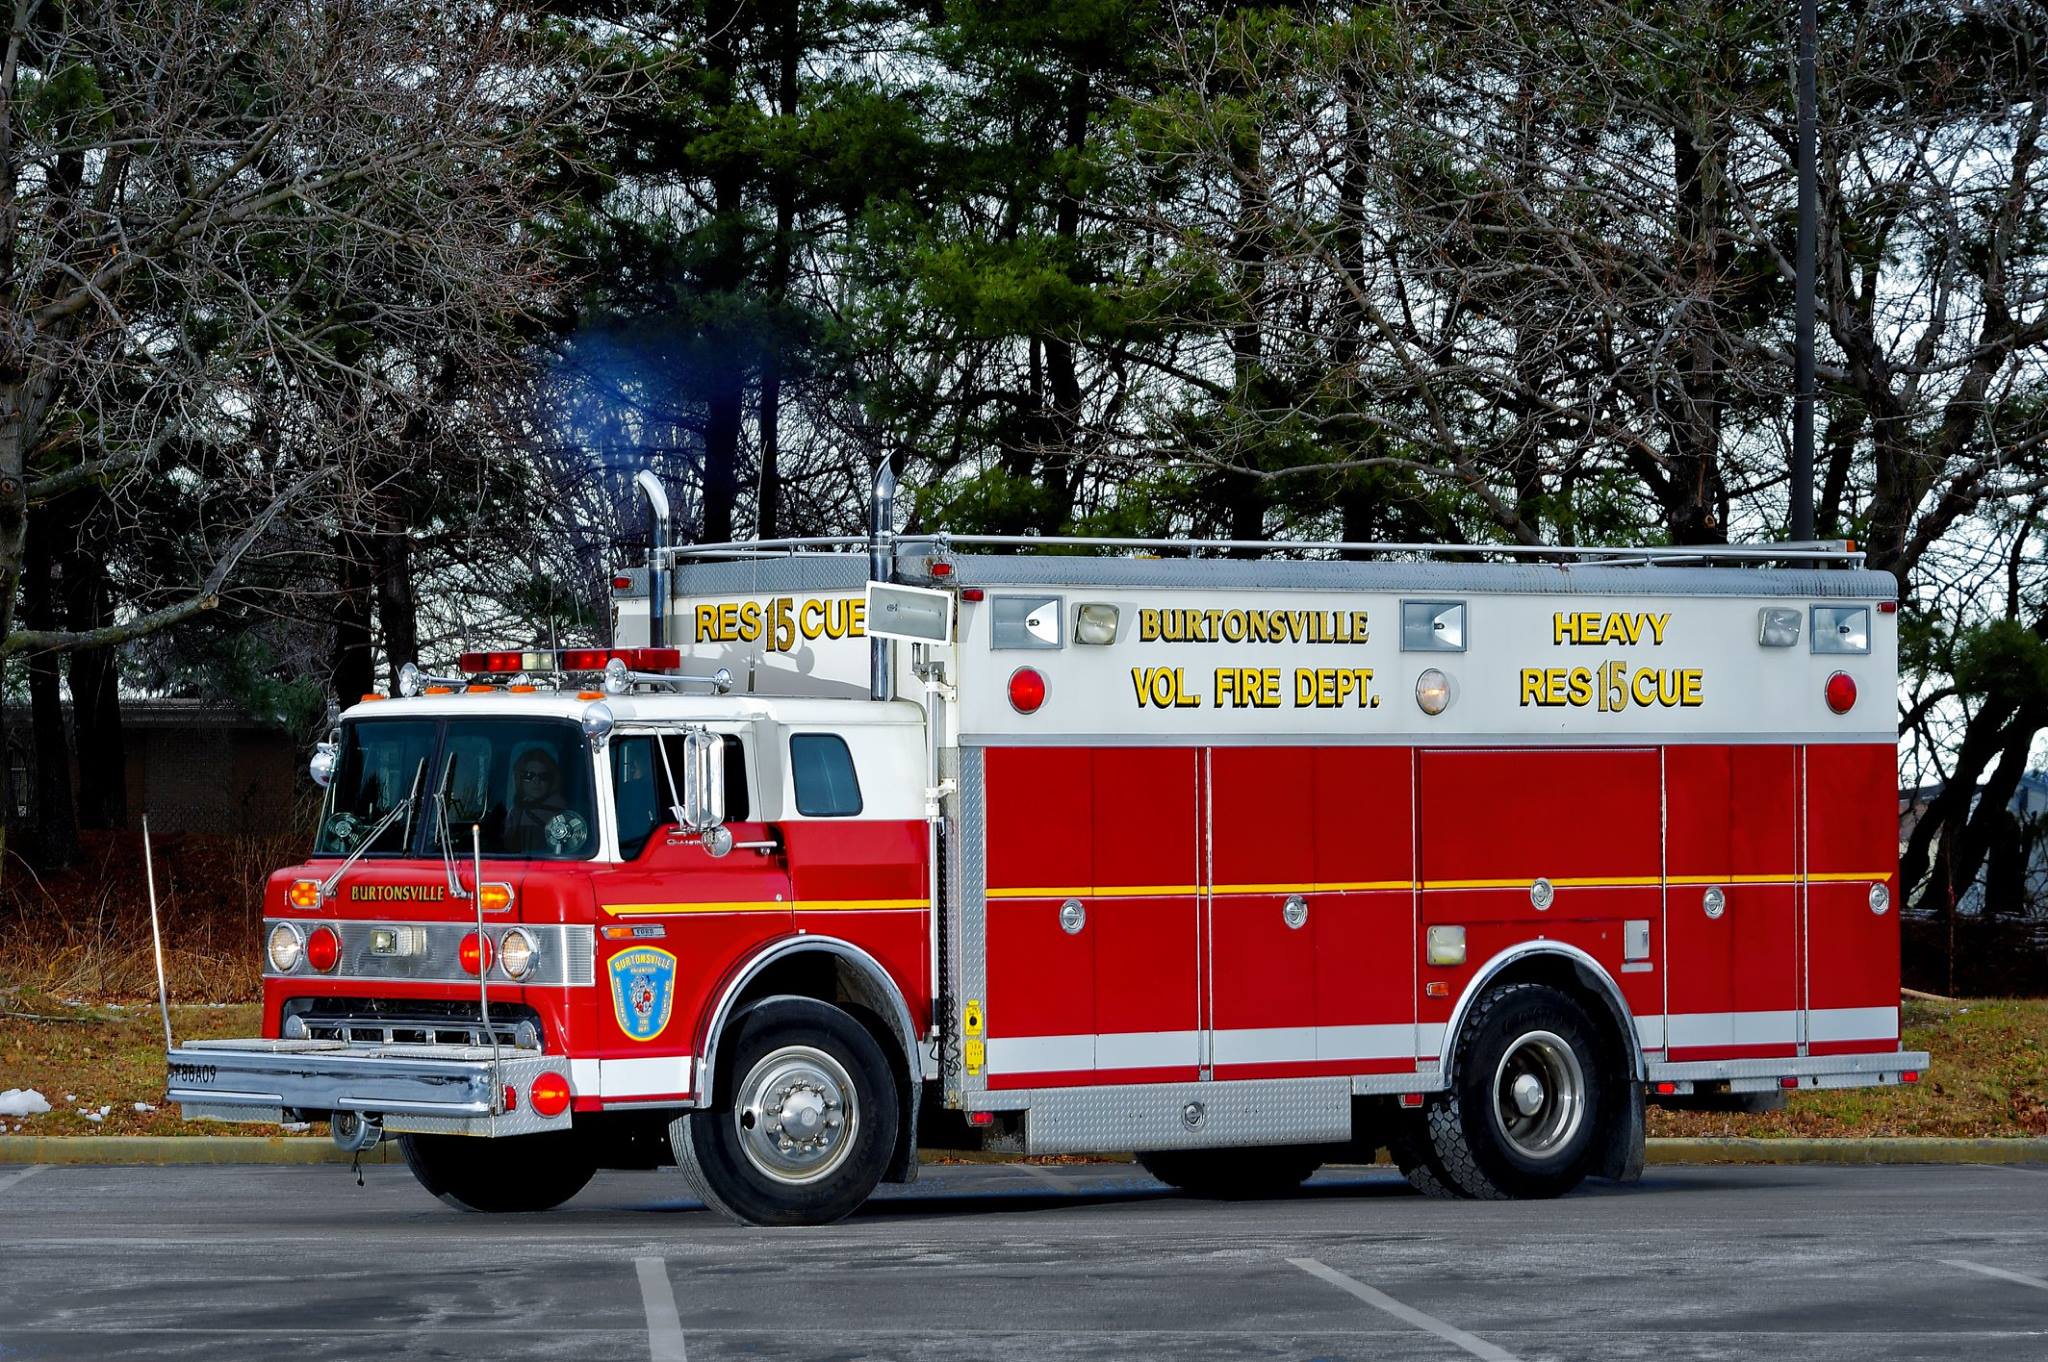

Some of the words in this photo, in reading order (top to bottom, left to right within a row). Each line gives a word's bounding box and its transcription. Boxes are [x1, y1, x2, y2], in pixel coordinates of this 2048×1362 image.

[1139, 608, 1370, 645] BURTONSVILLE
[1553, 612, 1672, 645] HEAVY
[1131, 666, 1201, 709] VOL.
[1214, 667, 1281, 709] FIRE
[1294, 667, 1380, 709] DEPT.
[351, 885, 445, 902] BURTONSVILLE
[614, 953, 671, 972] BURTONSVILLE
